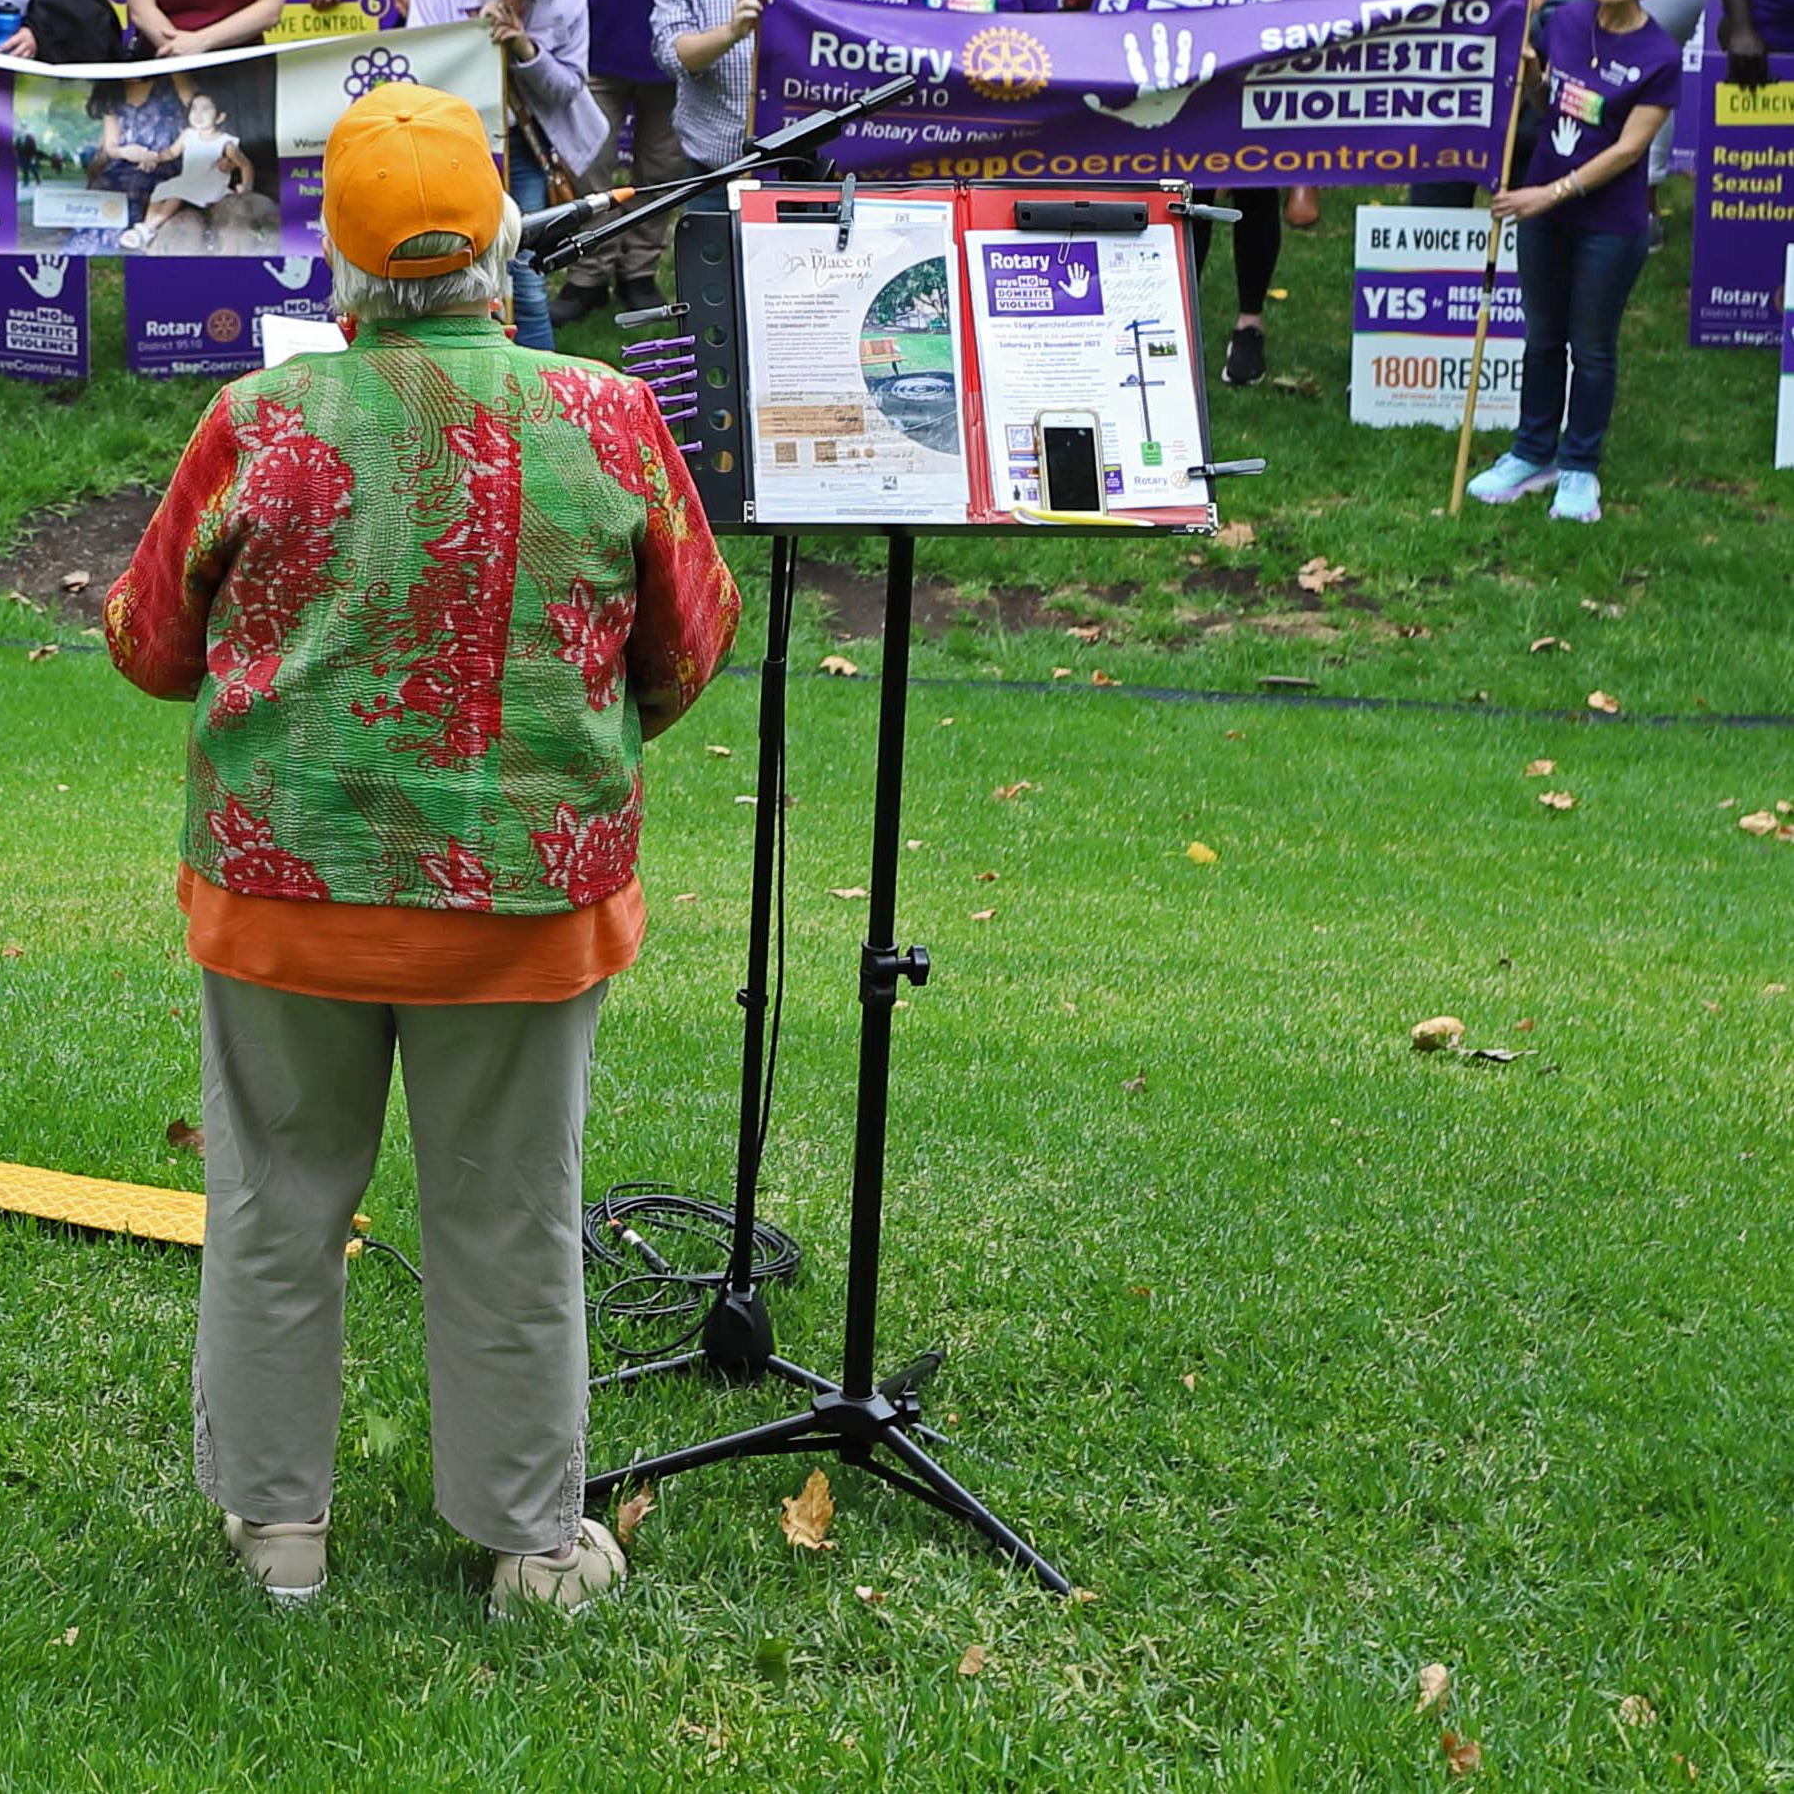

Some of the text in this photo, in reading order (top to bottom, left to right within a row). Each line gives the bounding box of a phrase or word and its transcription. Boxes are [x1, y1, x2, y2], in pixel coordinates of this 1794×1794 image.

[301, 14, 368, 33] CONTROL
[1260, 17, 1354, 52] says
[1451, 0, 1491, 26] to
[810, 31, 953, 84] Rotary
[1254, 88, 1483, 120] VIOLENCE
[845, 122, 1006, 144] a Rotary Club near
[1711, 173, 1783, 193] Sexual
[1371, 227, 1461, 250] BE A VOICE
[811, 253, 873, 270] Place of
[990, 252, 1050, 272] Rotary
[996, 277, 1050, 288] says NO to
[998, 289, 1049, 297] DOMESTIC
[1710, 287, 1770, 308] Rotary
[999, 301, 1051, 309] VIOLENCE
[1362, 287, 1427, 321] YES
[10, 322, 75, 339] DOMESTIC
[146, 321, 203, 338] Rotary
[10, 337, 75, 354] VIOLENCE
[1044, 340, 1082, 349] November
[1134, 476, 1168, 487] Rotary
